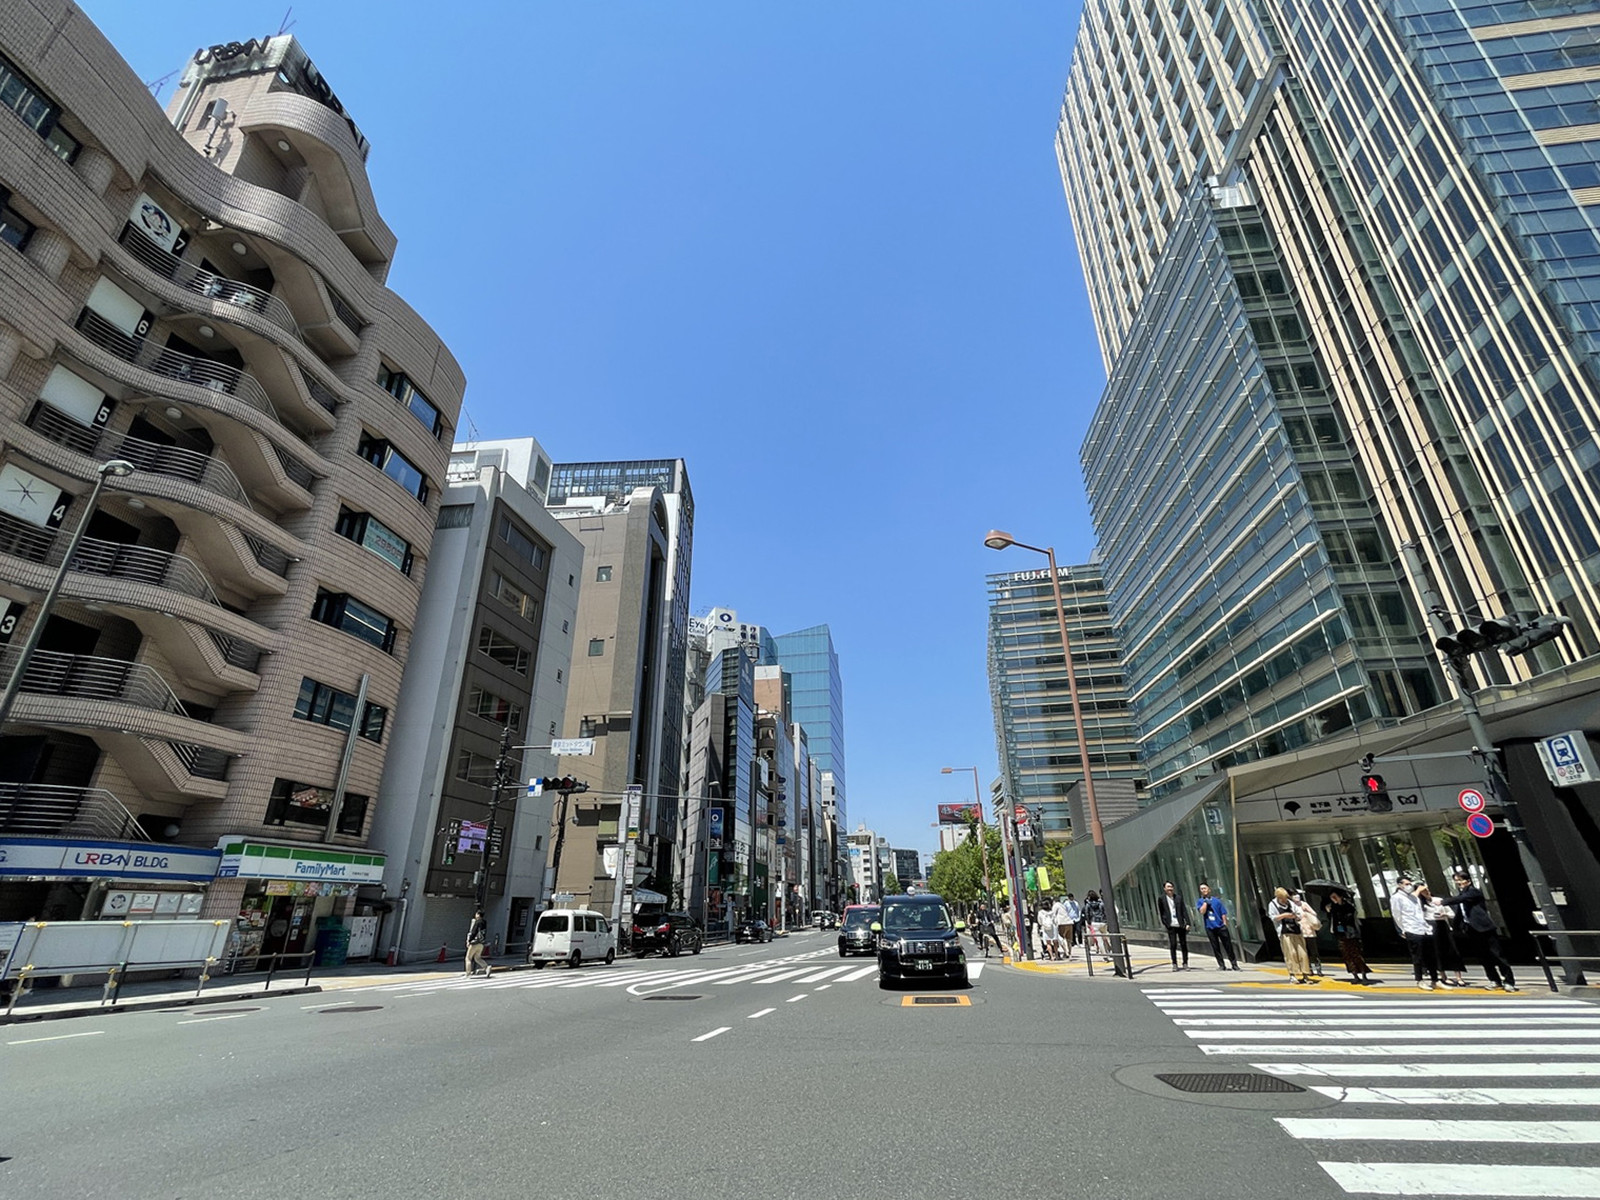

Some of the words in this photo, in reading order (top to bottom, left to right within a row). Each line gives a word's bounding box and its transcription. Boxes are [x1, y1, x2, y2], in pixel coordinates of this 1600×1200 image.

[174, 238, 186, 250] 7
[138, 319, 149, 335] 6
[98, 406, 110, 423] 5
[52, 504, 66, 521] 4
[1, 616, 16, 635] 3
[689, 617, 705, 629] Eye
[1464, 795, 1479, 807] 30
[75, 852, 131, 867] URBAN
[294, 861, 346, 877] FamilyMart
